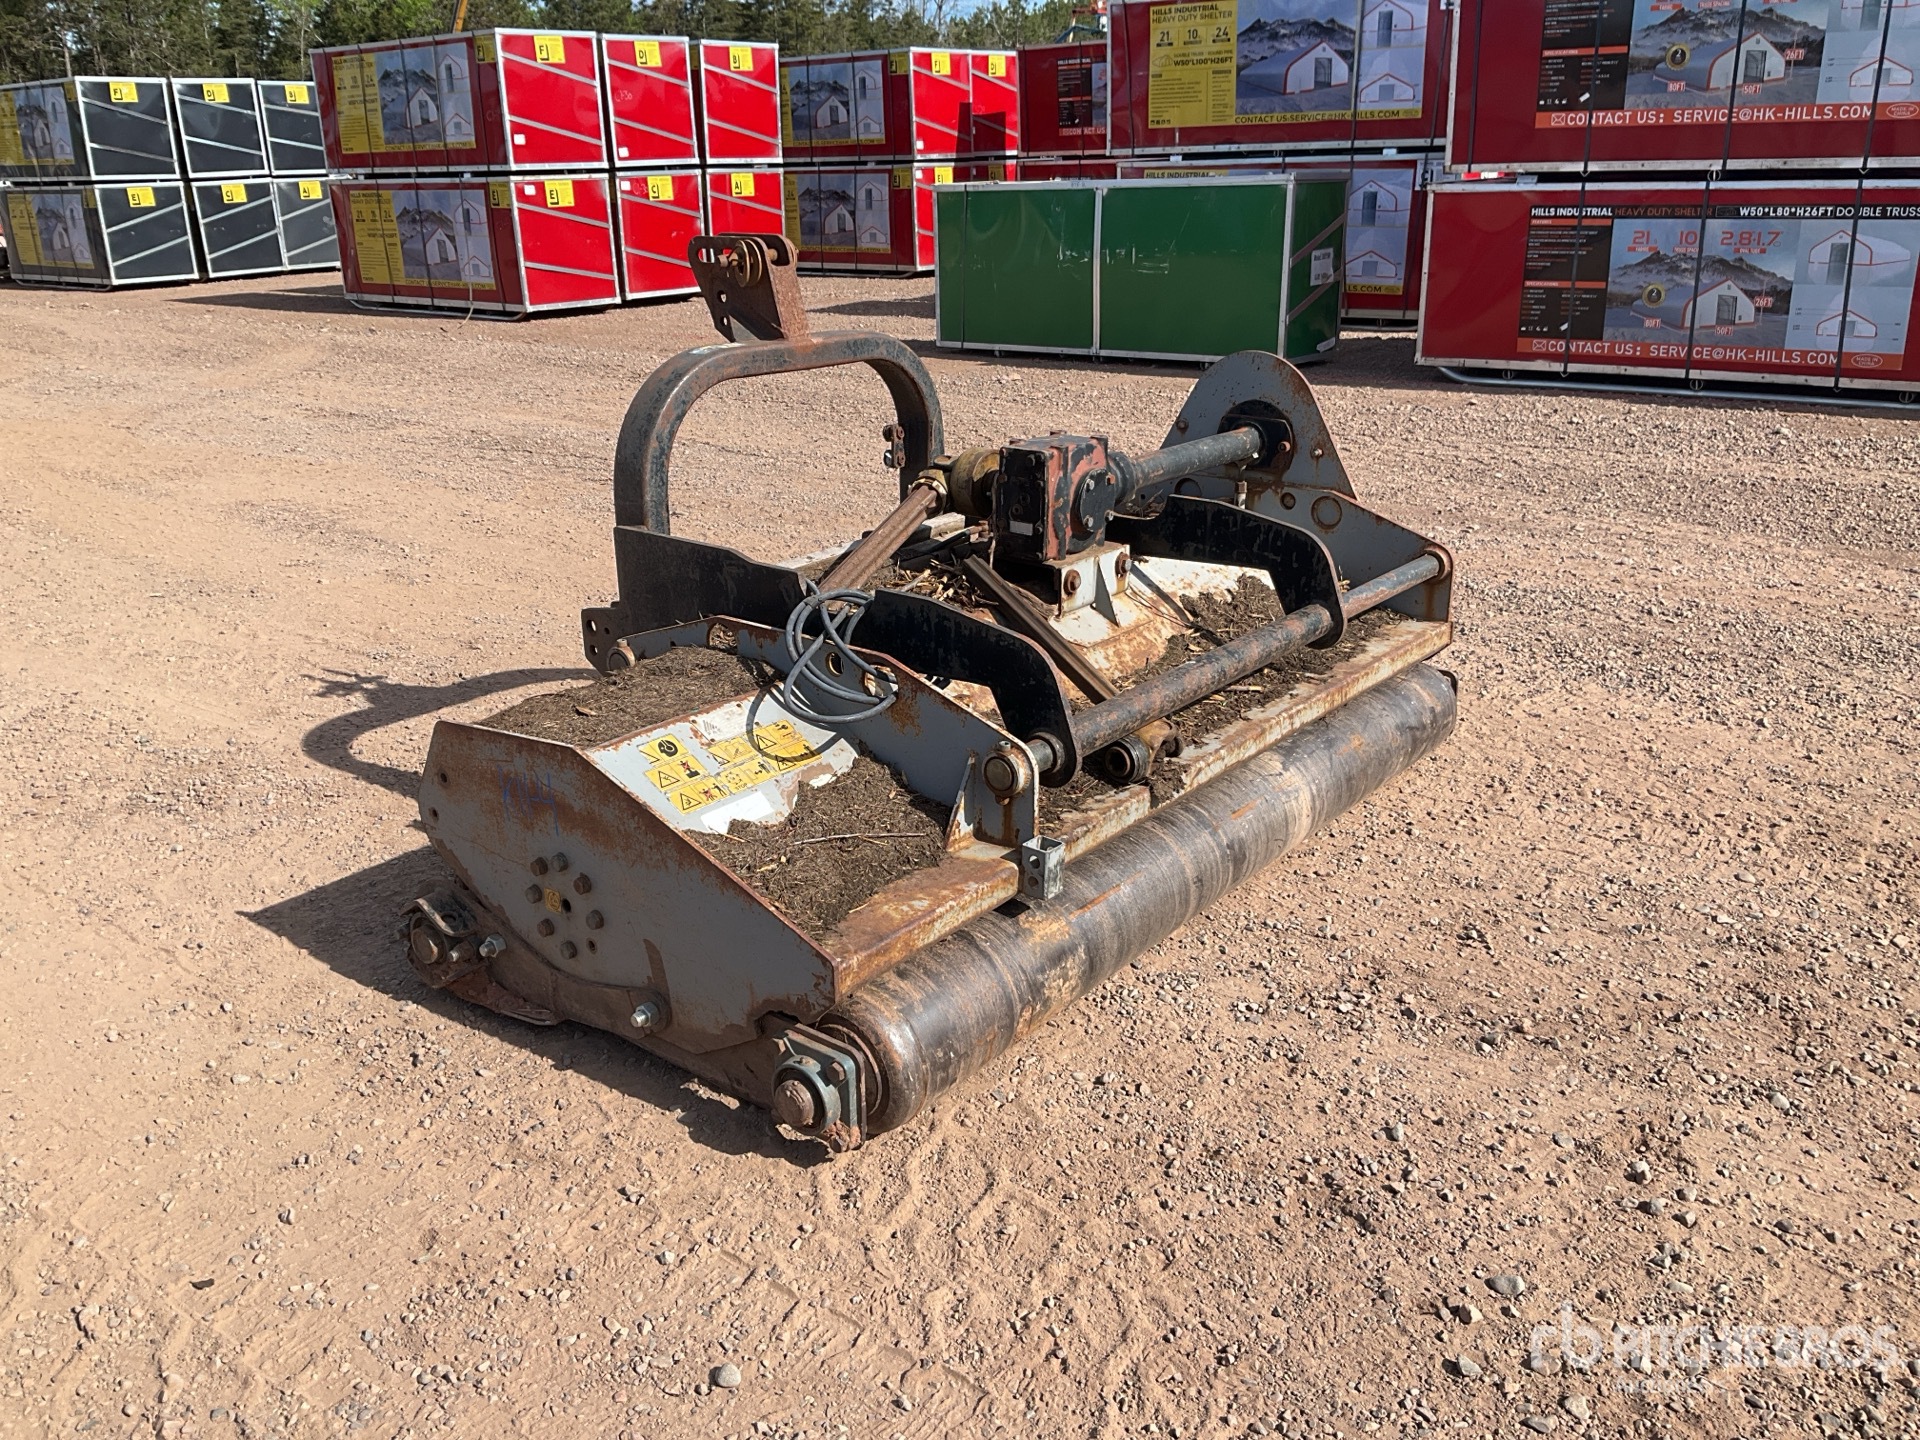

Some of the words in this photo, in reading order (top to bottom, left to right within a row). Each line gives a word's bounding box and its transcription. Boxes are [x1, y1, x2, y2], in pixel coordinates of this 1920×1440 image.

[1152, 6, 1172, 16] HILLS
[1174, 4, 1219, 14] INDUSTRIAL
[1152, 15, 1176, 24] HEAVY
[1177, 13, 1198, 22] DUTY
[1199, 11, 1233, 20] SHELTER
[1160, 31, 1170, 41] 21
[1187, 29, 1198, 39] 10
[1215, 26, 1229, 38] 24
[1786, 50, 1804, 60] 26FT
[1744, 85, 1761, 94] 50FT
[1235, 115, 1274, 124] CONTACT
[1567, 111, 1632, 126] CONTACT
[1637, 111, 1664, 124] US:
[1531, 207, 1555, 216] HILLS
[1556, 207, 1613, 216] INDUSTRIAL
[1615, 207, 1646, 216] HEAVY
[1647, 207, 1673, 216] DUTY
[1674, 207, 1713, 216] SHELTR
[1632, 230, 1650, 245] 21
[1680, 230, 1698, 246] 10
[1755, 298, 1772, 307] 26FT
[1548, 341, 1610, 354] CONTACT
[1615, 343, 1641, 356] US:
[1649, 345, 1838, 365] SERVCE@HK-HILLS.COM
